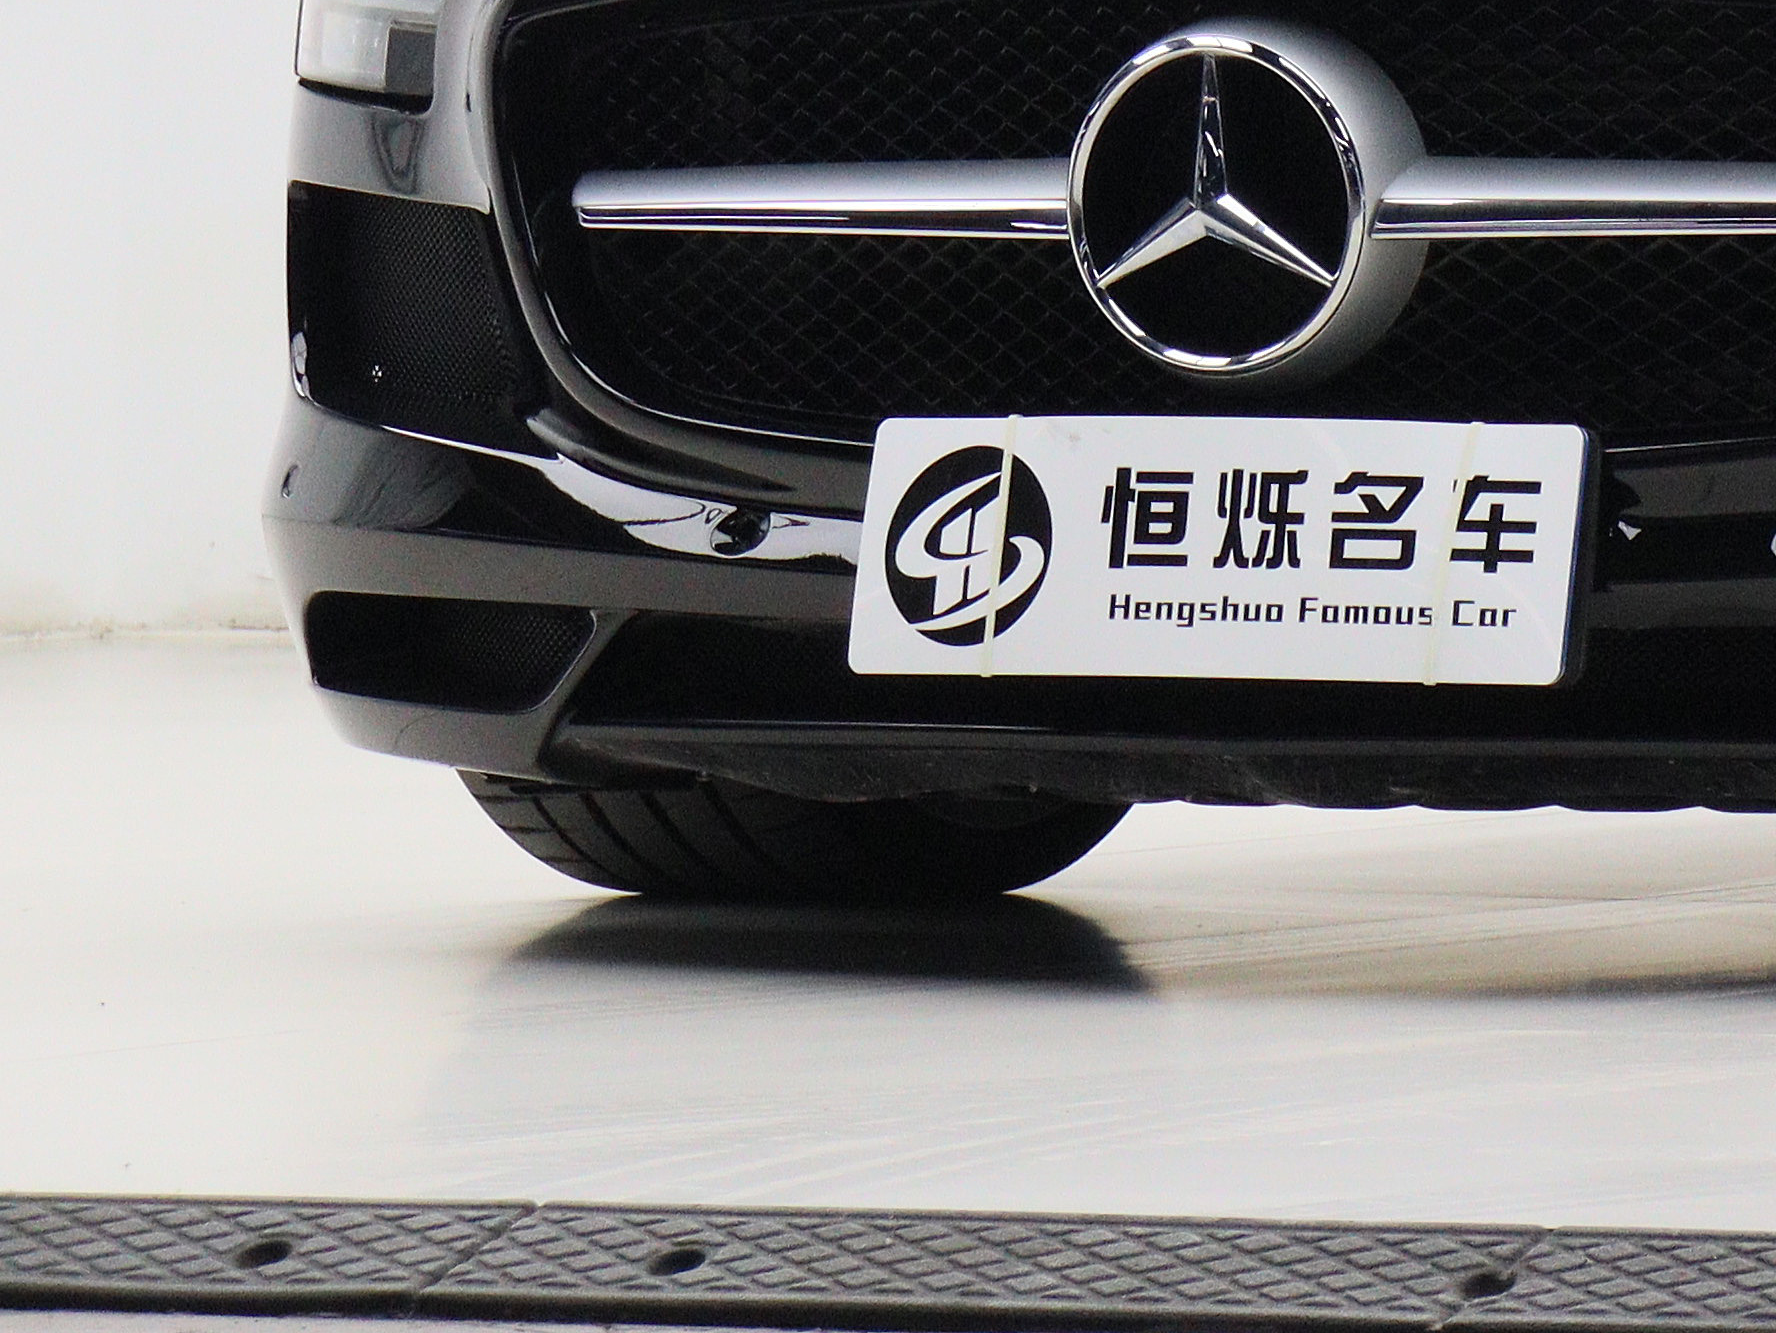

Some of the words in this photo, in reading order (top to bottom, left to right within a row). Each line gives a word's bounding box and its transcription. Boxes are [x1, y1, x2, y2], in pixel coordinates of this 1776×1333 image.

[1100, 467, 1543, 575] 恒烁名车
[1108, 593, 1285, 629] Hengshuo
[1297, 596, 1434, 627] Famous
[1450, 599, 1518, 628] Car
